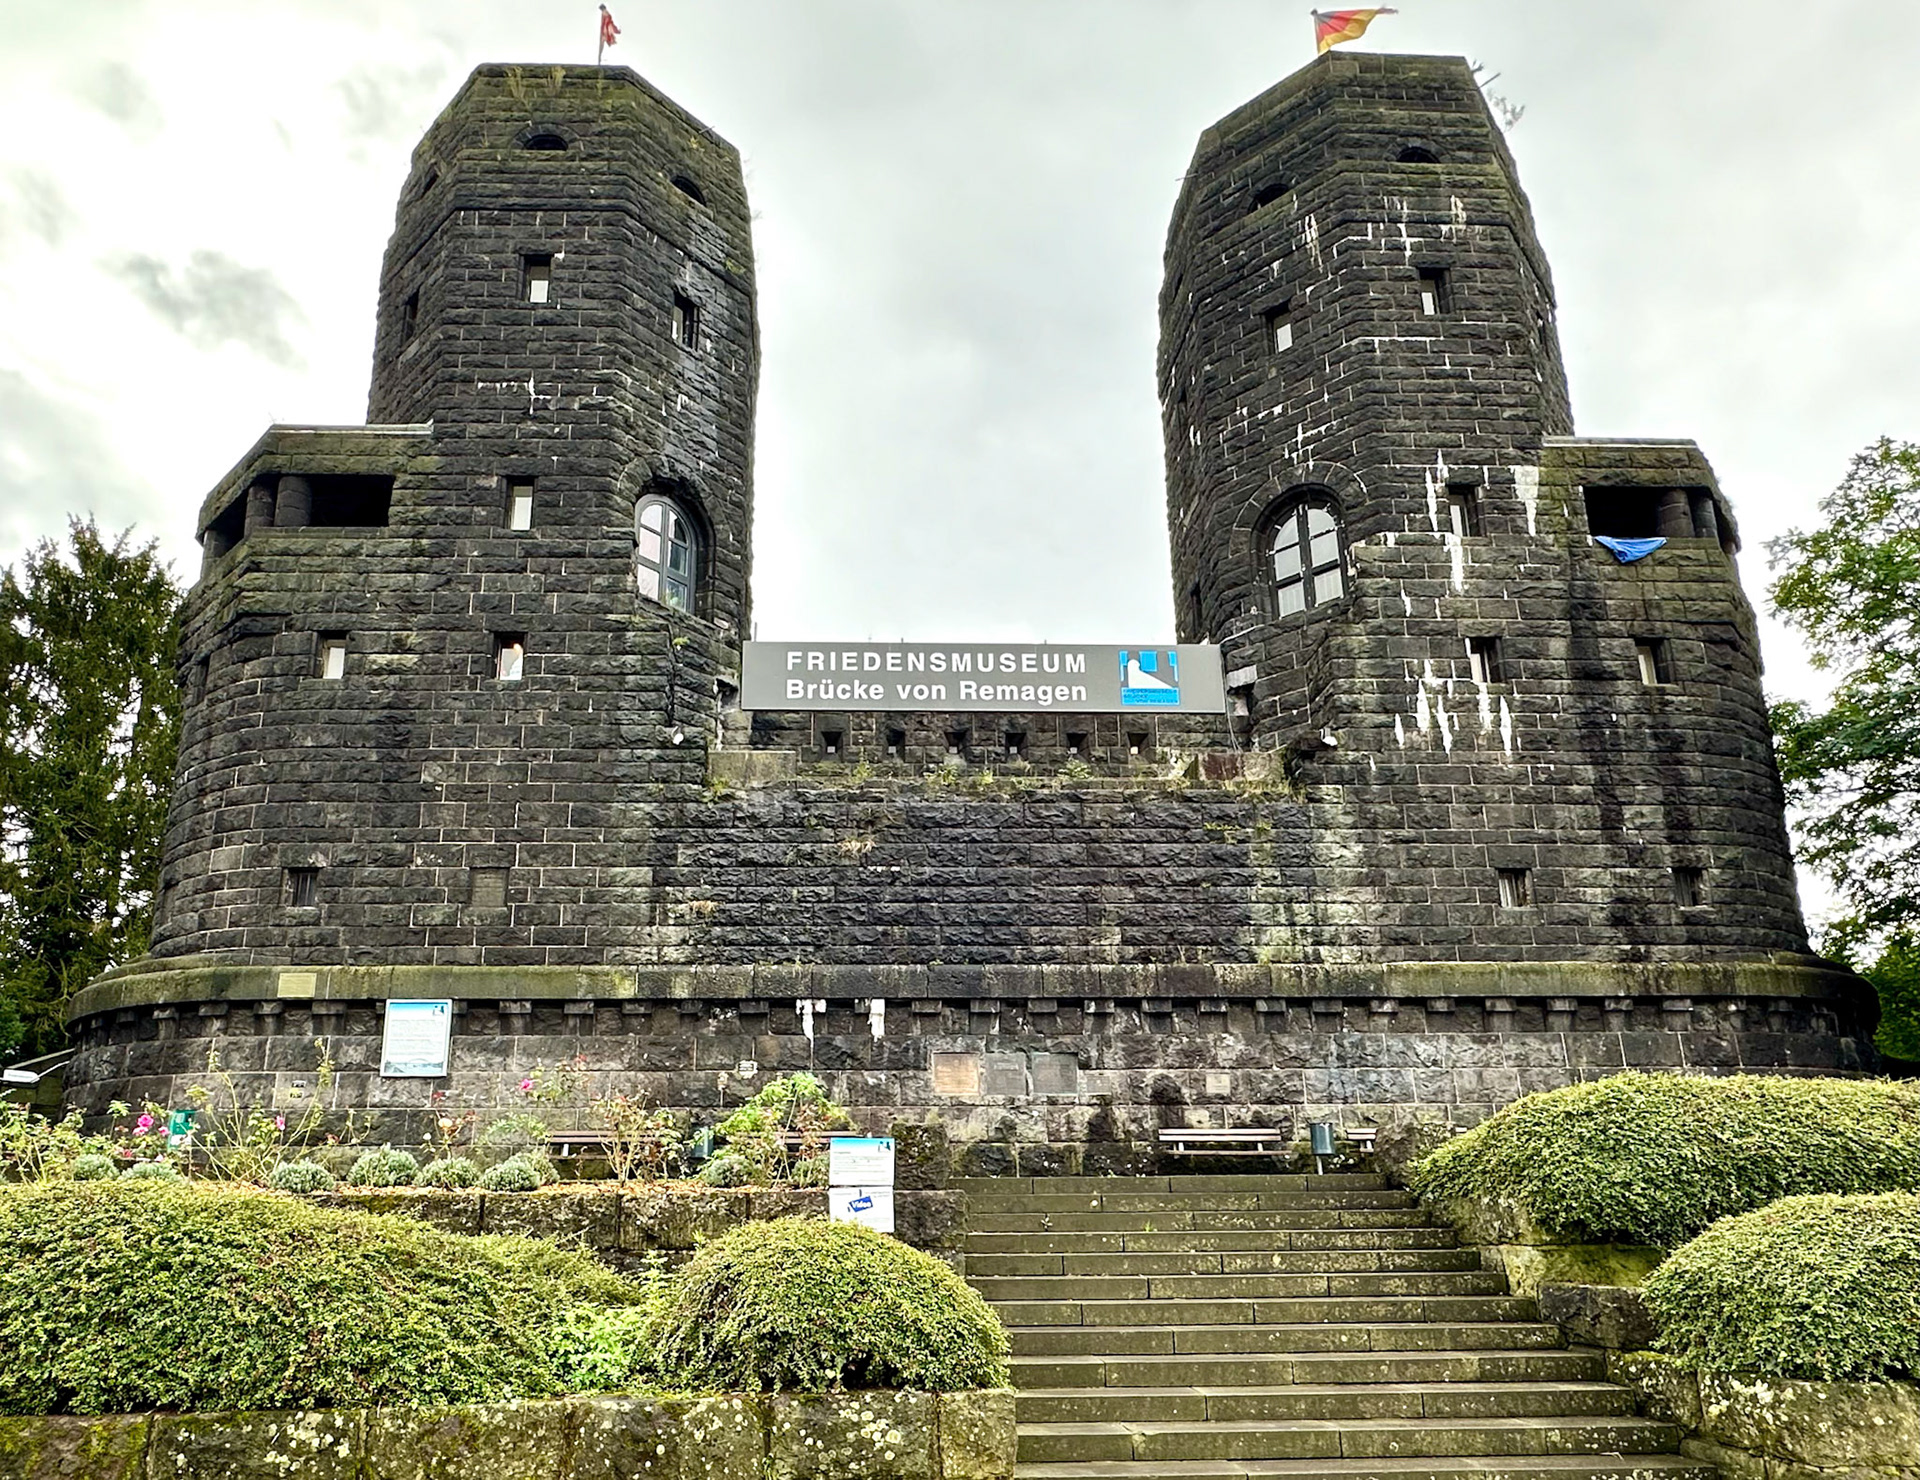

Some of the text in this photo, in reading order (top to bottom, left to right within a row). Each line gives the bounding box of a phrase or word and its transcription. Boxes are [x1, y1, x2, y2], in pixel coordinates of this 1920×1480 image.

[786, 651, 1086, 674] FRIEDENSMUSEUM
[786, 679, 1087, 706] Brücke von Remagen
